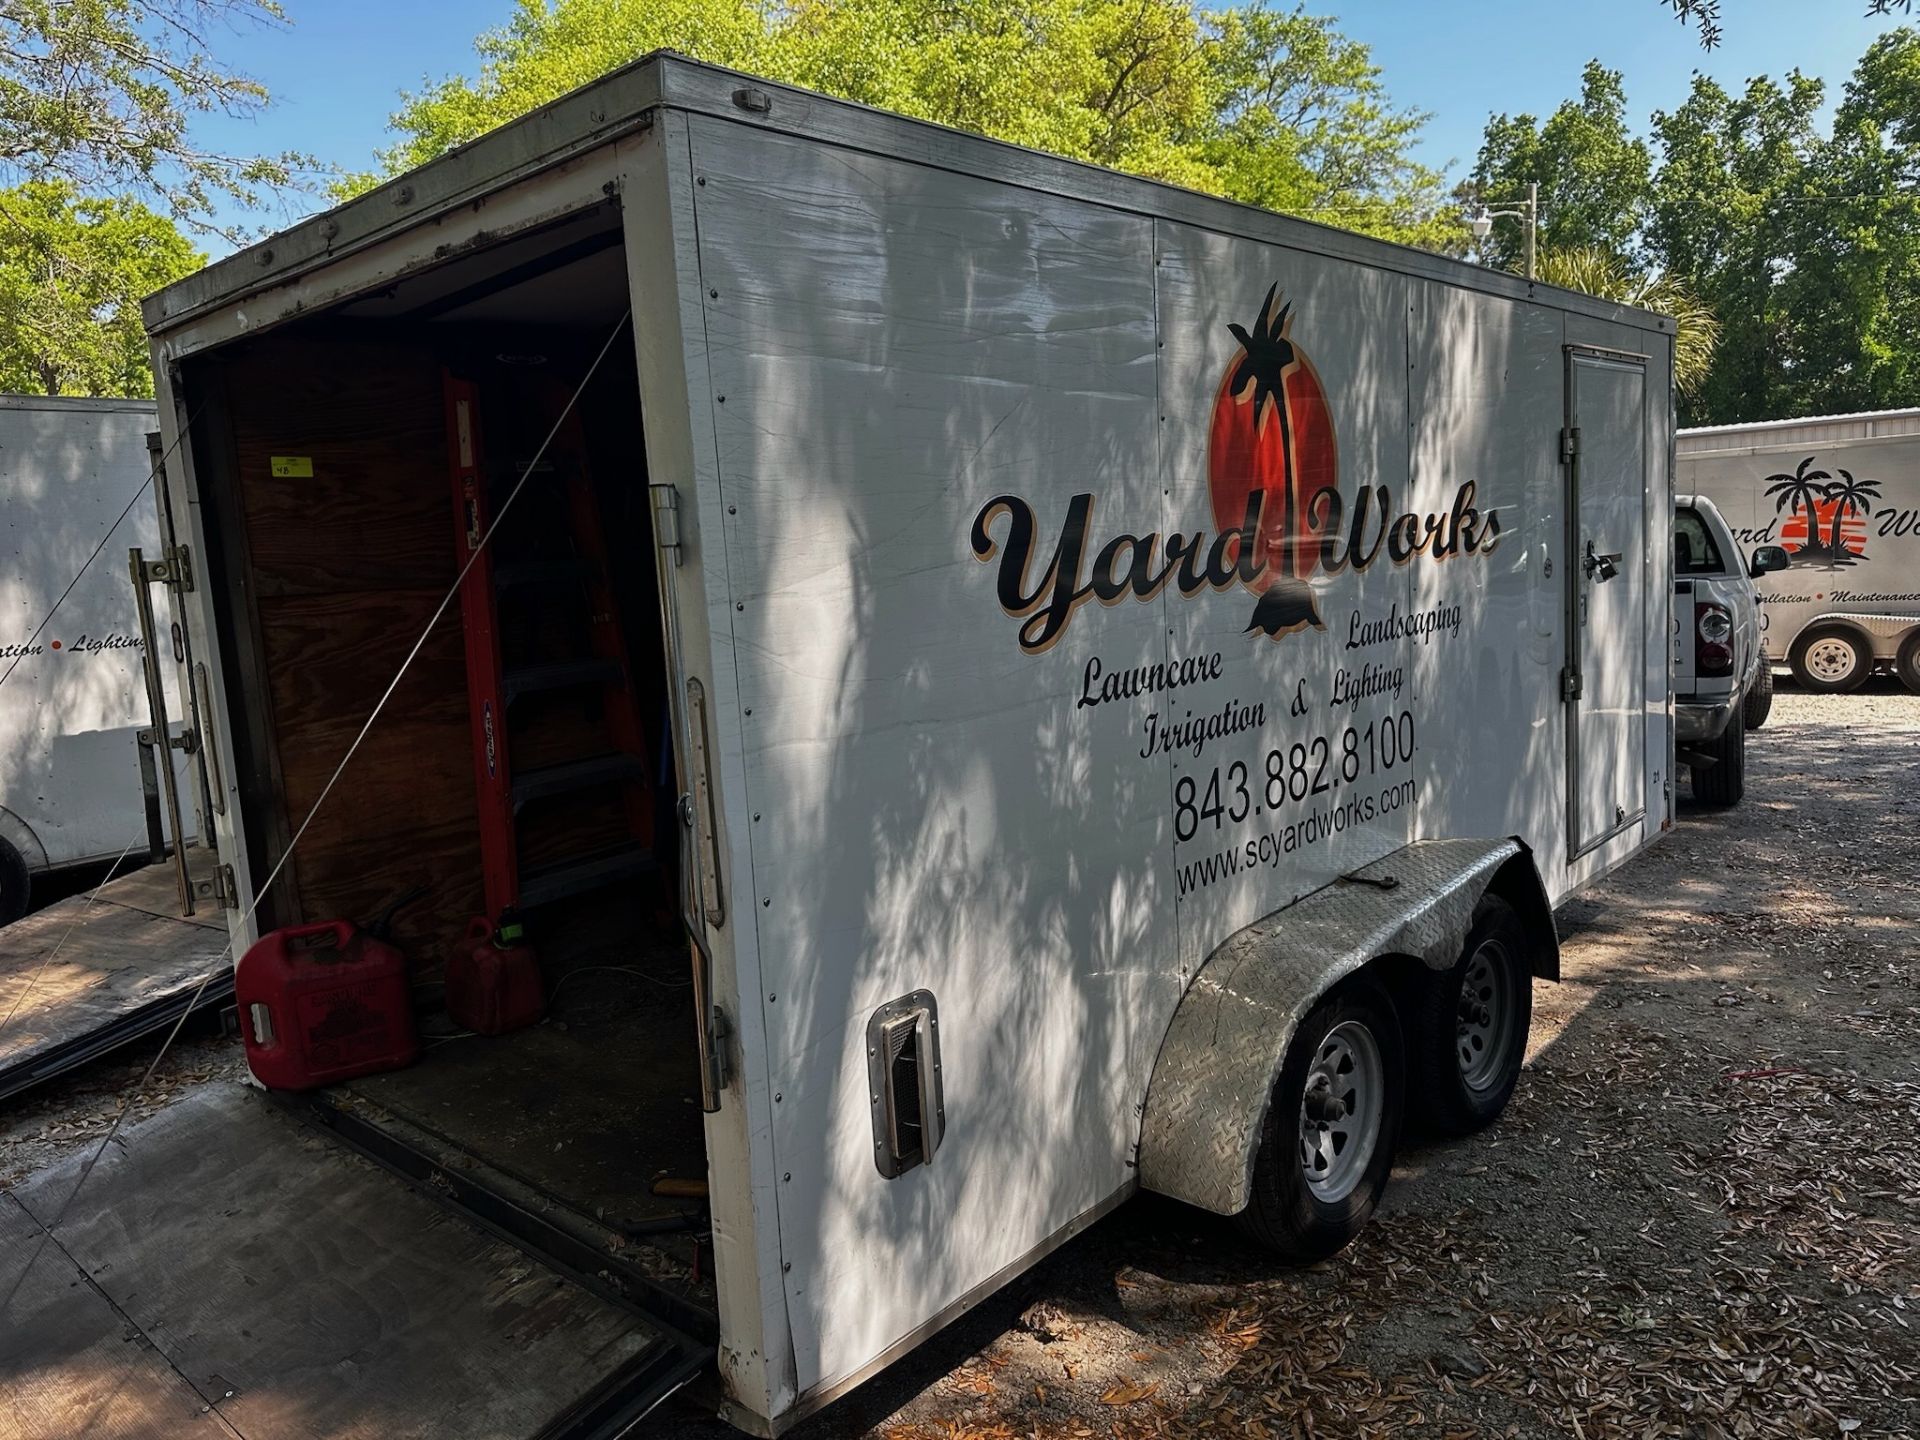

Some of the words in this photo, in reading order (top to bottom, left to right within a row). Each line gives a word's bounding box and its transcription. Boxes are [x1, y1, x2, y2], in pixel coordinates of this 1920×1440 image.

[970, 489, 1269, 656] Yard
[1307, 480, 1501, 575] Works
[1731, 517, 1777, 543] rd
[1345, 601, 1462, 650] Landscaping
[1830, 590, 1920, 602] Maintenance
[1077, 652, 1223, 709] Lawncare
[1140, 700, 1265, 759] Irrigation
[1291, 678, 1308, 718] &
[1330, 661, 1404, 712] Lighting
[1174, 710, 1415, 843] 843.882.8100
[1176, 778, 1417, 895] www.scyardworks.com
